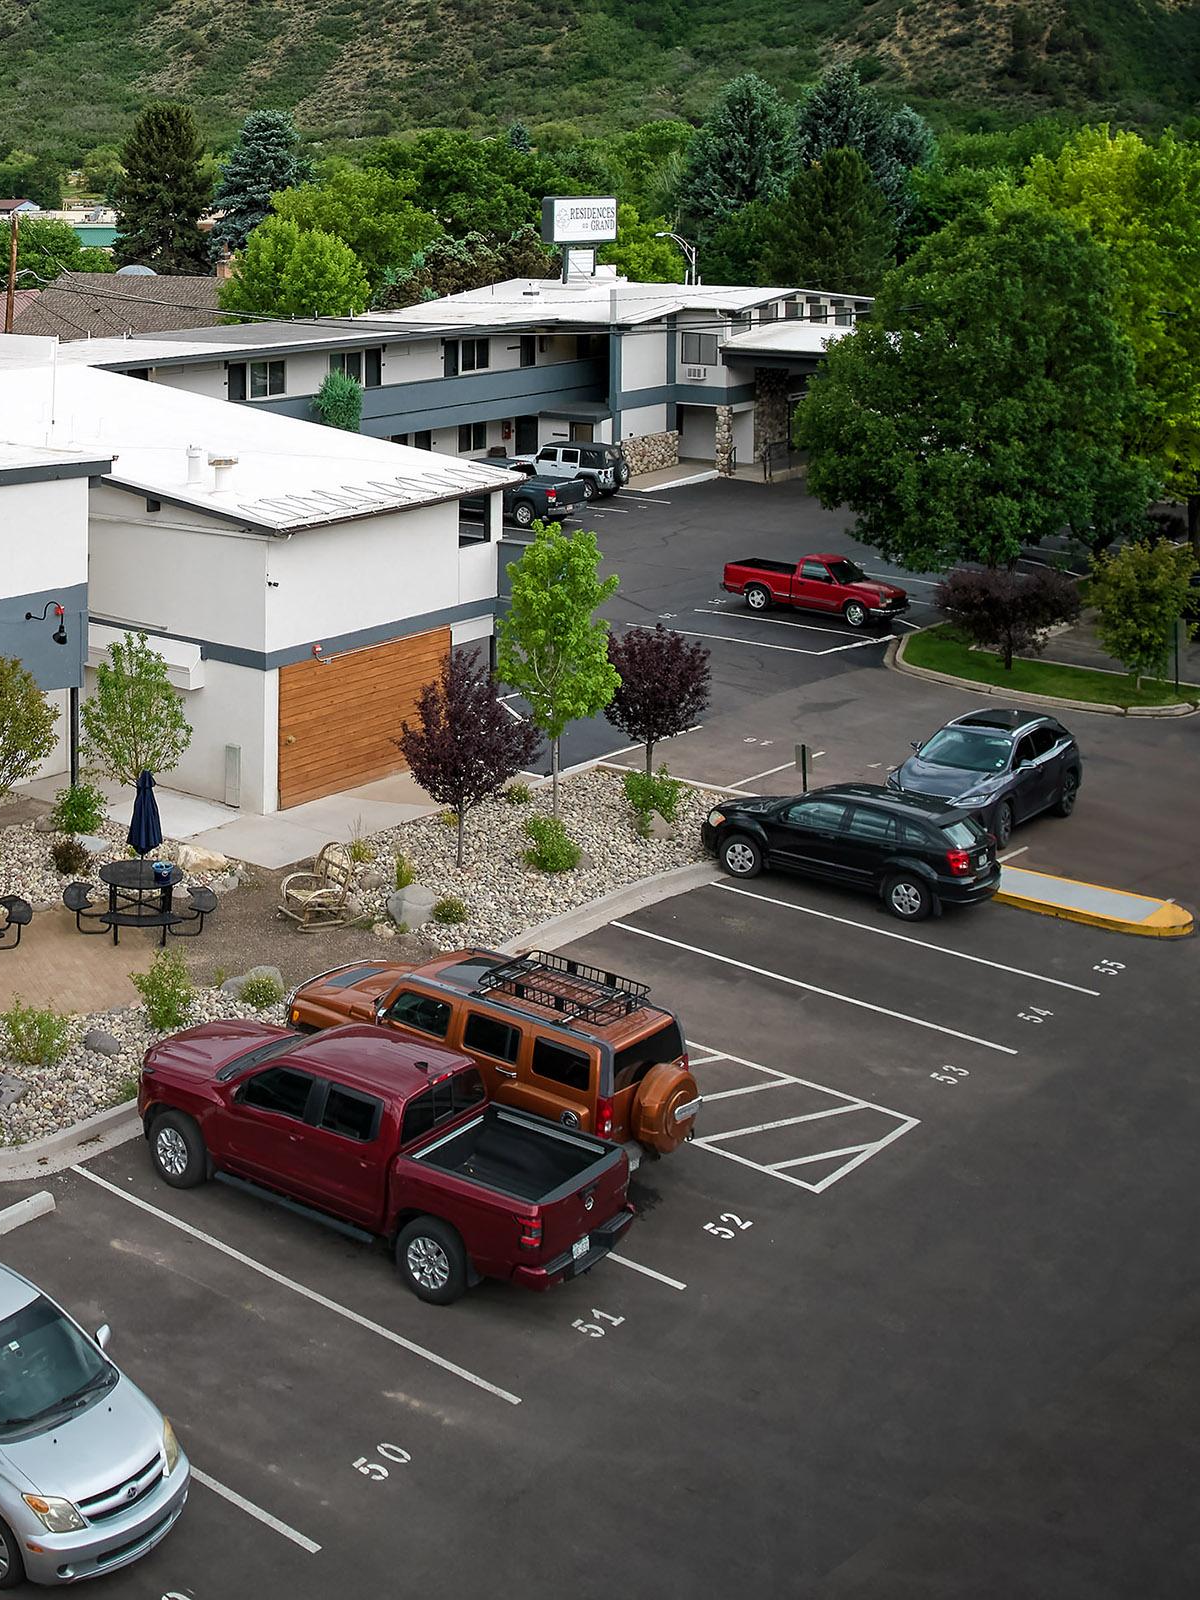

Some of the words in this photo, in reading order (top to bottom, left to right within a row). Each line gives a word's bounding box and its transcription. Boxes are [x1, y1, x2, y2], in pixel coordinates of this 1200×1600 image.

[570, 207, 615, 220] RESIDENCES
[590, 219, 615, 231] GRAND
[1092, 959, 1127, 976] 55
[1017, 1006, 1054, 1024] 54
[930, 1064, 970, 1085] 53
[702, 1212, 754, 1239] 52
[570, 1308, 626, 1338] 51
[352, 1442, 412, 1481] 50
